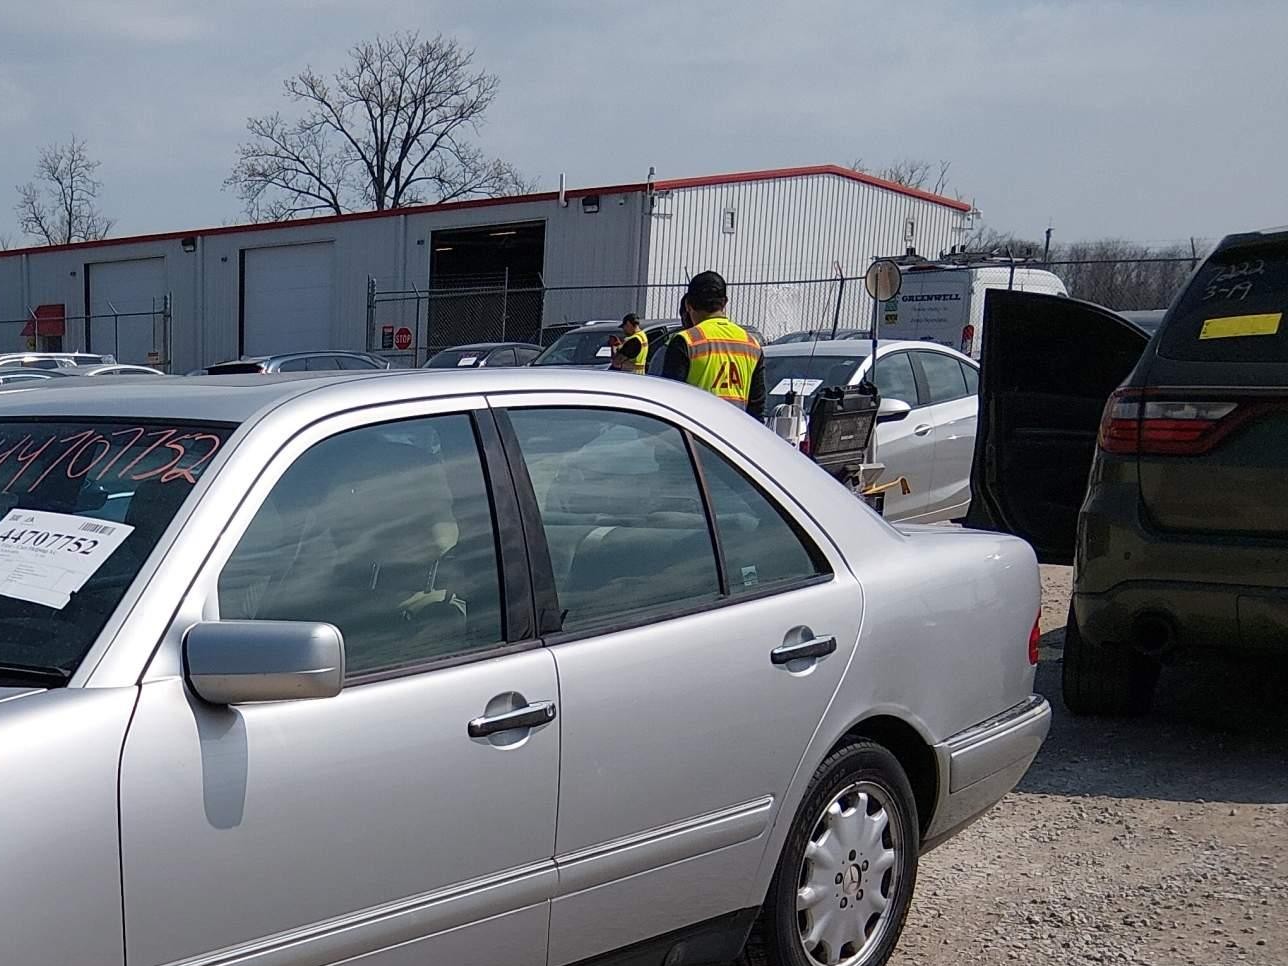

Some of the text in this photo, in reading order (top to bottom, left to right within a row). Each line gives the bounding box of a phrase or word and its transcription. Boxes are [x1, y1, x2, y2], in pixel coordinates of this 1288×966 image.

[901, 294, 961, 302] GREENWELL
[395, 334, 411, 344] STOP
[0, 528, 99, 555] 44707752
